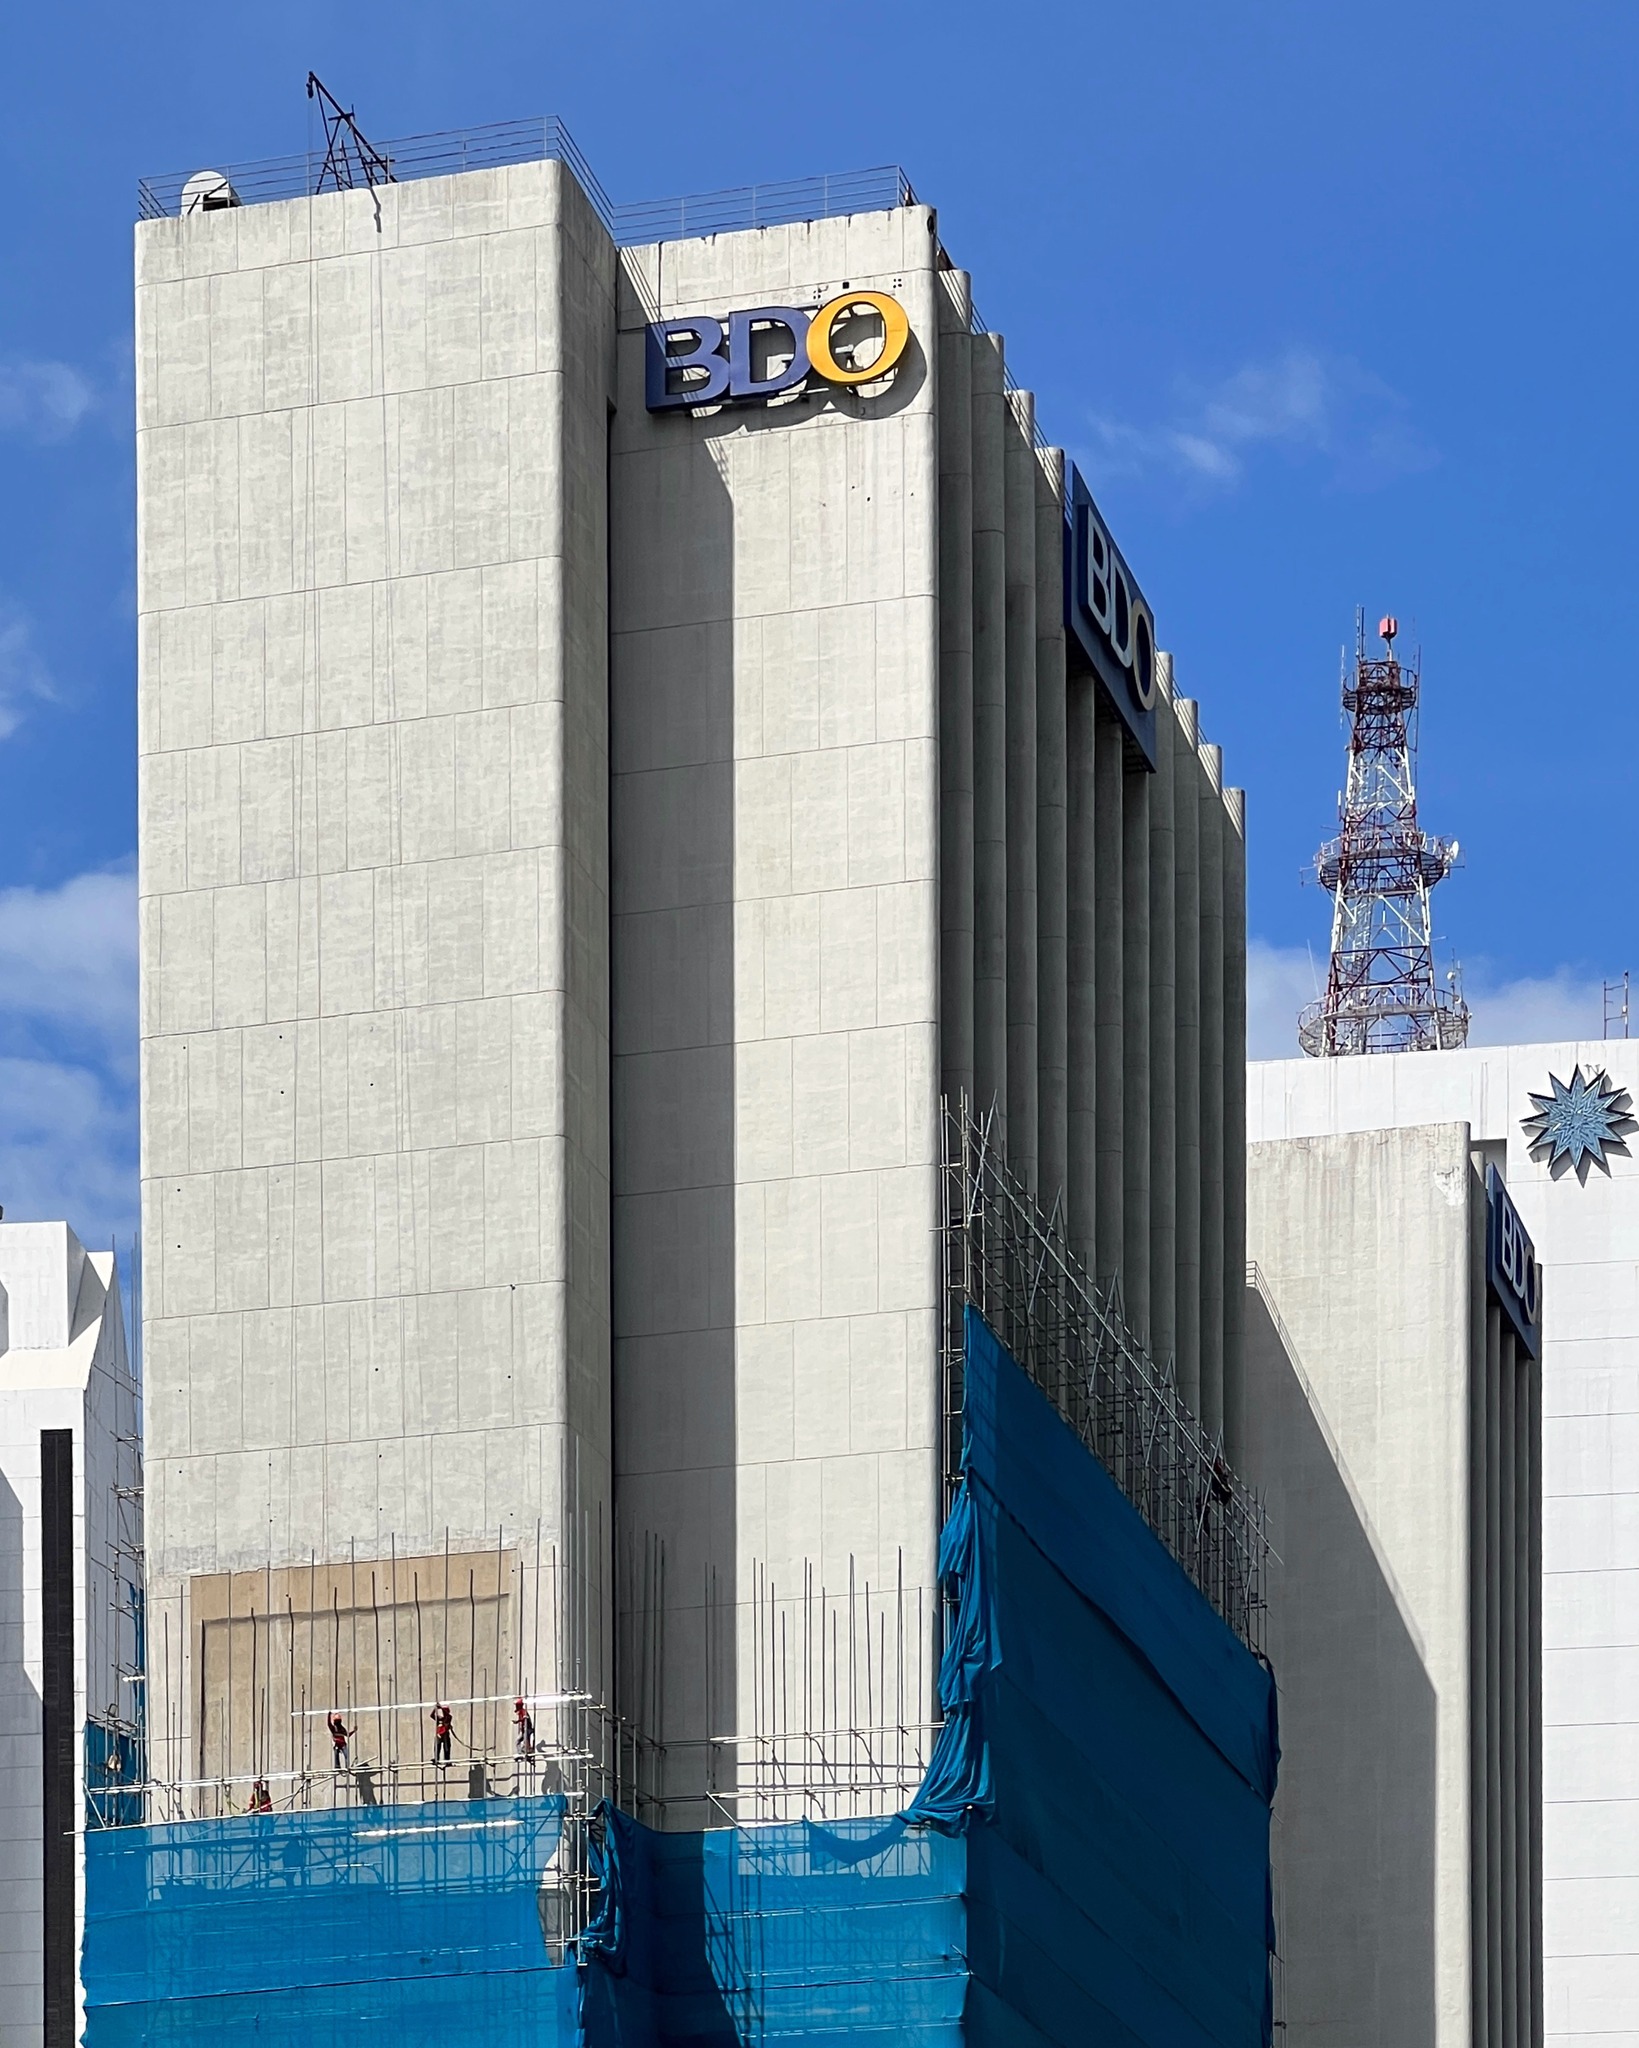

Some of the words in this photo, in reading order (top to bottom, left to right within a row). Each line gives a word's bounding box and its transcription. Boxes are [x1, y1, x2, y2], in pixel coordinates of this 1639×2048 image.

[646, 291, 909, 413] BDO
[1080, 504, 1156, 711] BDO
[1499, 1192, 1537, 1326] BDO
